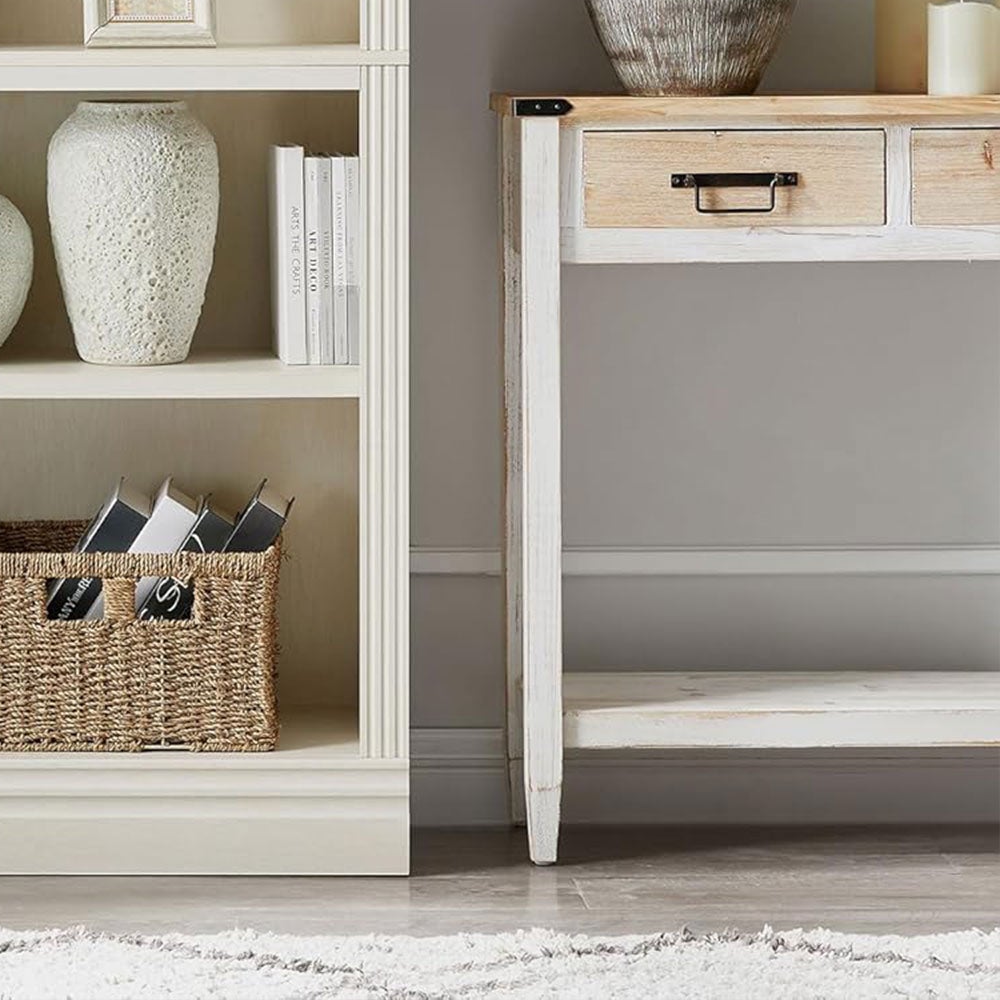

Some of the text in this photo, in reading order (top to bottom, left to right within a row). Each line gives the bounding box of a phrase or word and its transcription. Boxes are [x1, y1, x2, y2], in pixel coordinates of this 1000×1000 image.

[290, 205, 301, 295] ARTS THE CRAFTS
[308, 231, 318, 292] ART DECO
